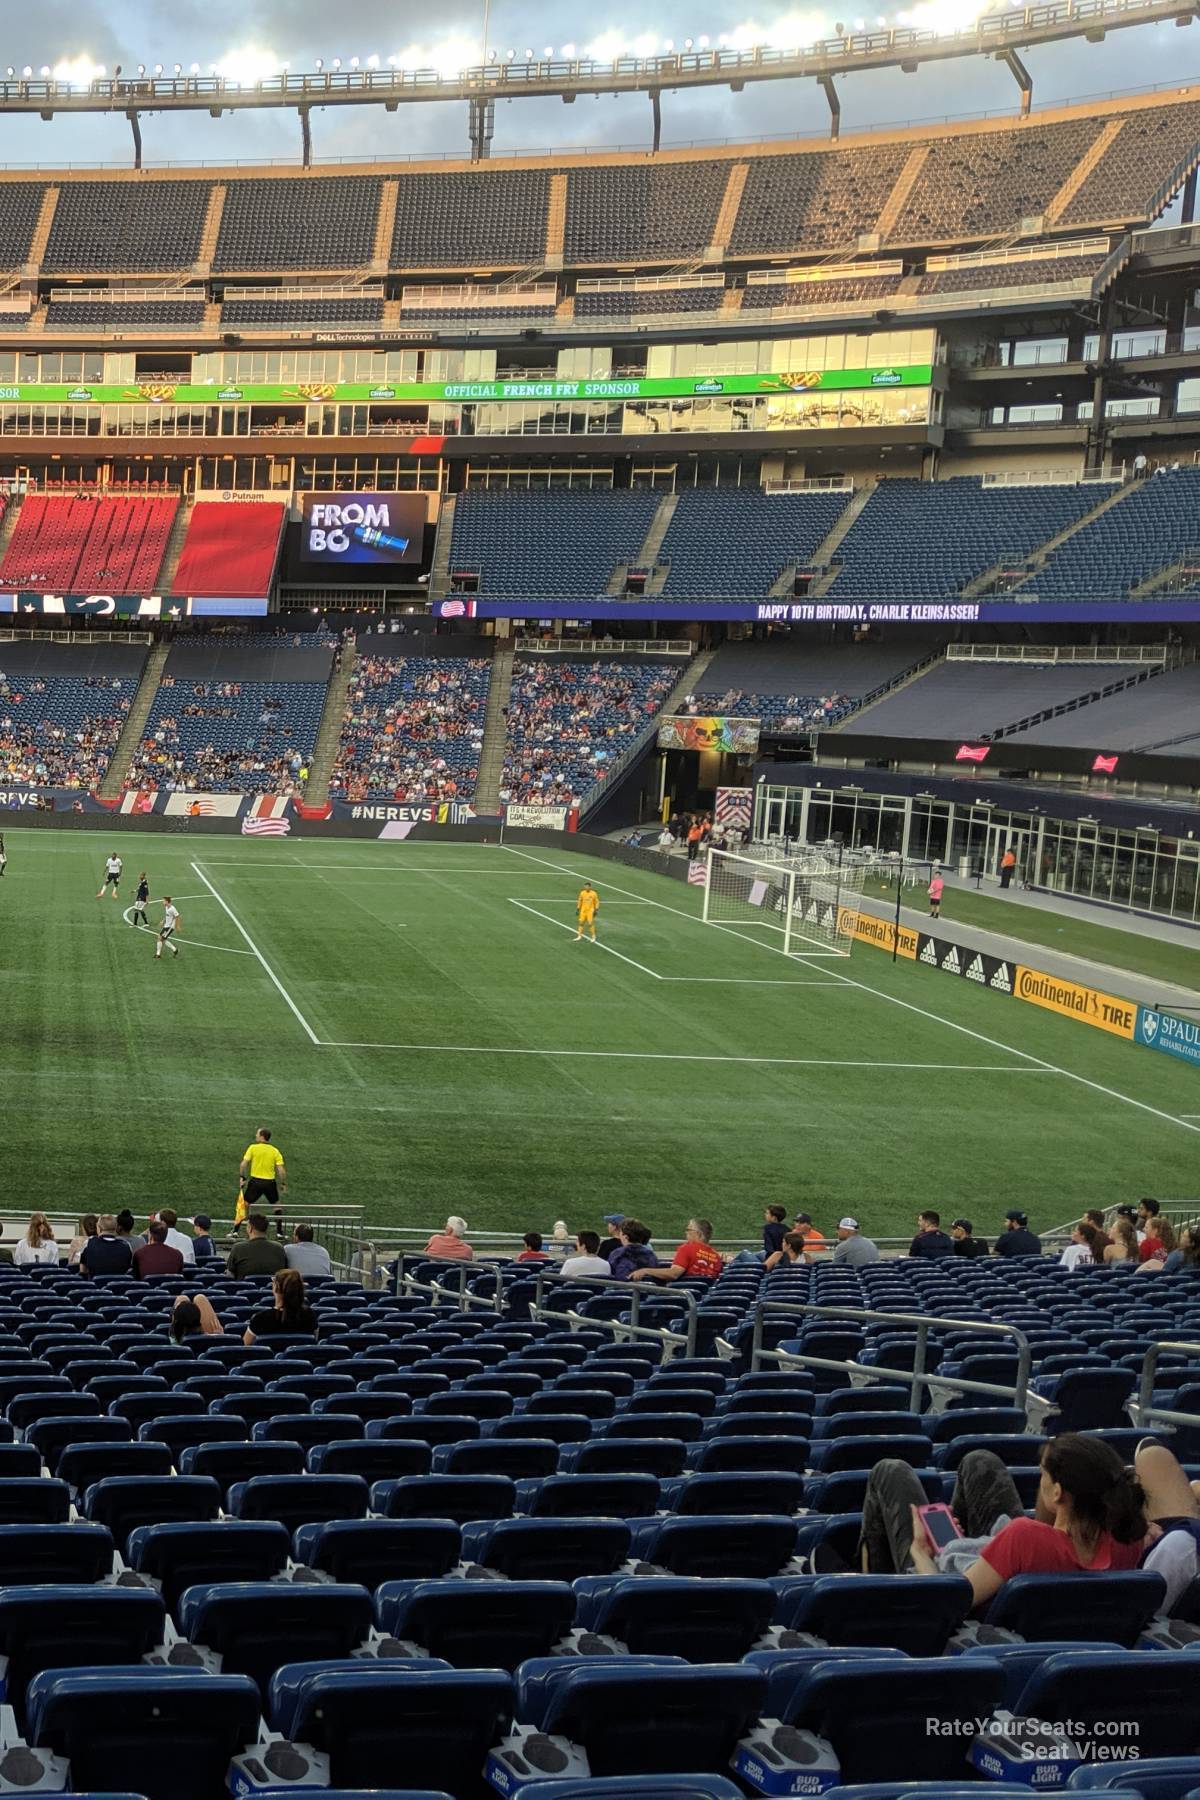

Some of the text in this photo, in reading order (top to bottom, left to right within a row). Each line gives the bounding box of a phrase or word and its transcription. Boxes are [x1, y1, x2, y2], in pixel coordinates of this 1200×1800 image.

[872, 375, 901, 384] Cavendish
[444, 383, 640, 397] OFFICIAL FRENCH FRY SPONSOR
[695, 383, 723, 391] Cavendish
[310, 503, 390, 527] FROM
[758, 605, 979, 620] HAPPY 10TH BIRTHDAY, CHARLIE KLEINSASSER!
[352, 806, 432, 821] #NEREVS
[920, 953, 937, 966] adidas
[942, 960, 960, 974] adidas
[966, 969, 985, 983] adidas
[990, 978, 1011, 992] adidas
[1020, 970, 1132, 1029] Continental TIRE
[1161, 1016, 1200, 1046] SPAUL
[980, 1759, 1004, 1776] LIGHT
[984, 1754, 1002, 1768] BUD
[1036, 1765, 1059, 1774] BUD
[796, 1775, 821, 1785] BUD
[1031, 1772, 1062, 1783] LIGHT
[791, 1784, 824, 1793] LIGHT
